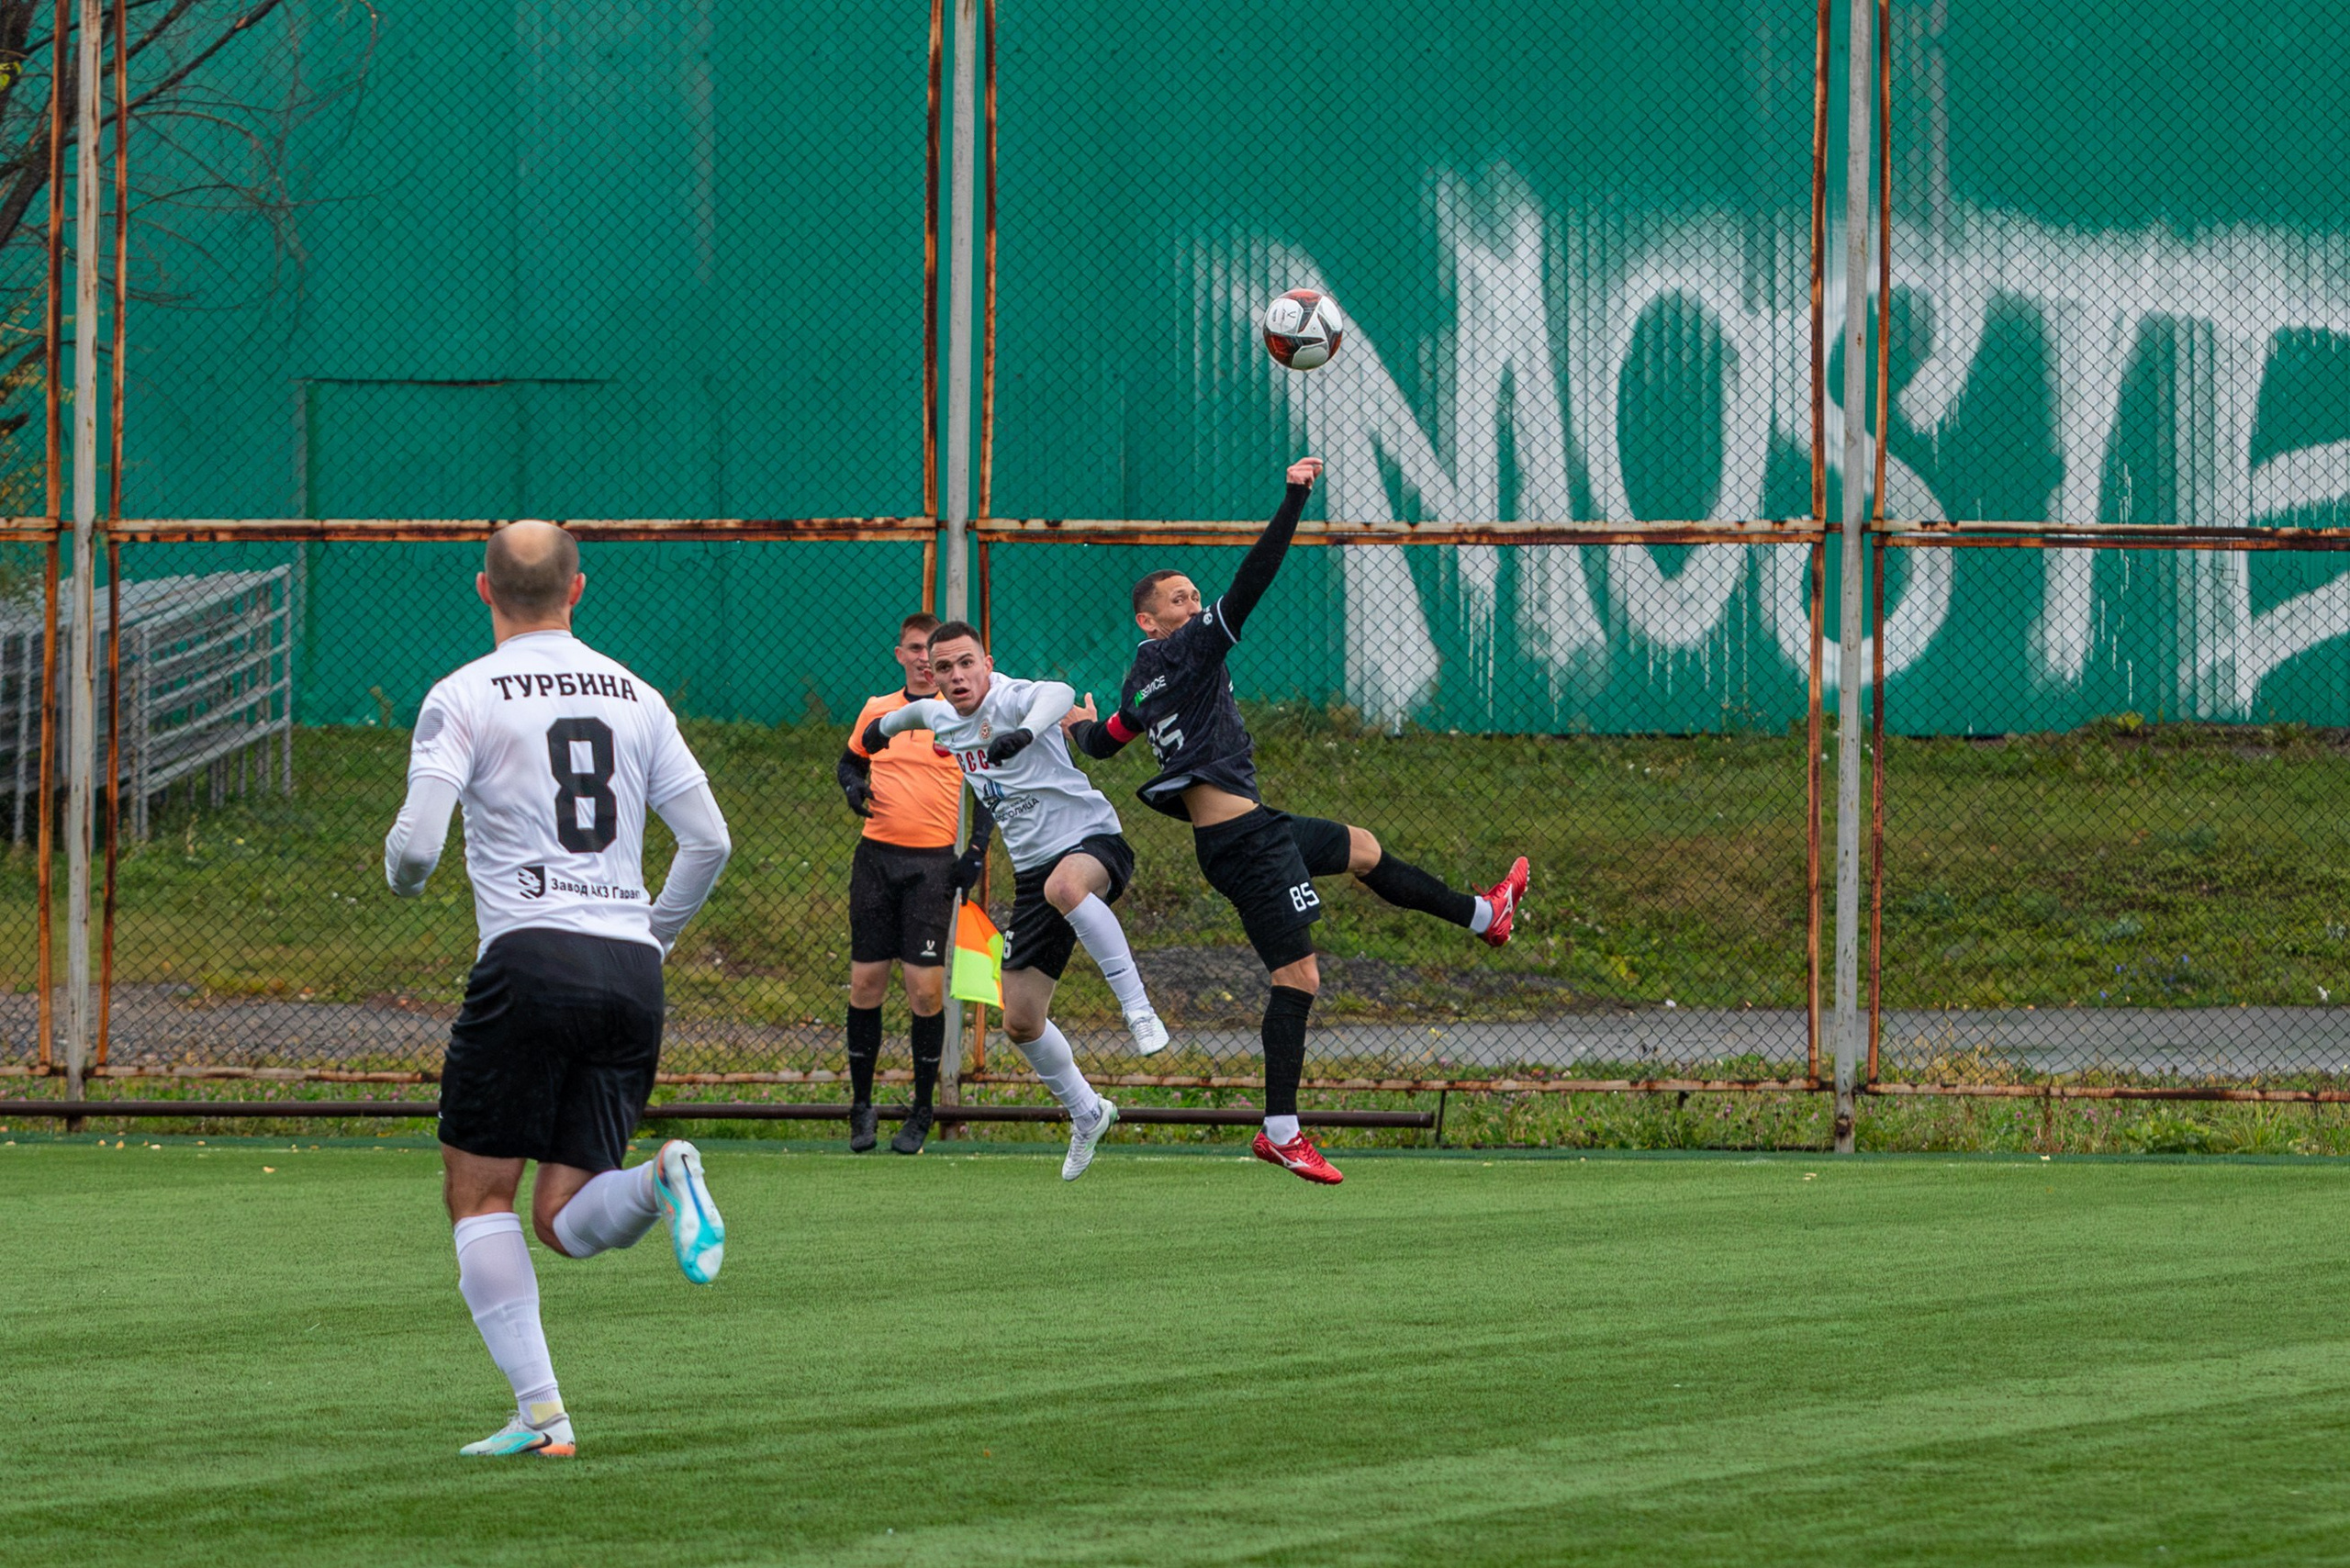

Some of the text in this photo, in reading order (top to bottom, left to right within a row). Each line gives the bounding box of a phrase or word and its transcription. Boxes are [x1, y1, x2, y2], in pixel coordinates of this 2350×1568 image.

[491, 672, 638, 702] ТУРБИНА
[956, 748, 990, 773] ССС
[546, 716, 617, 854] 8
[551, 878, 588, 897] Завод
[591, 884, 610, 898] АКЗ
[1289, 881, 1320, 912] 85
